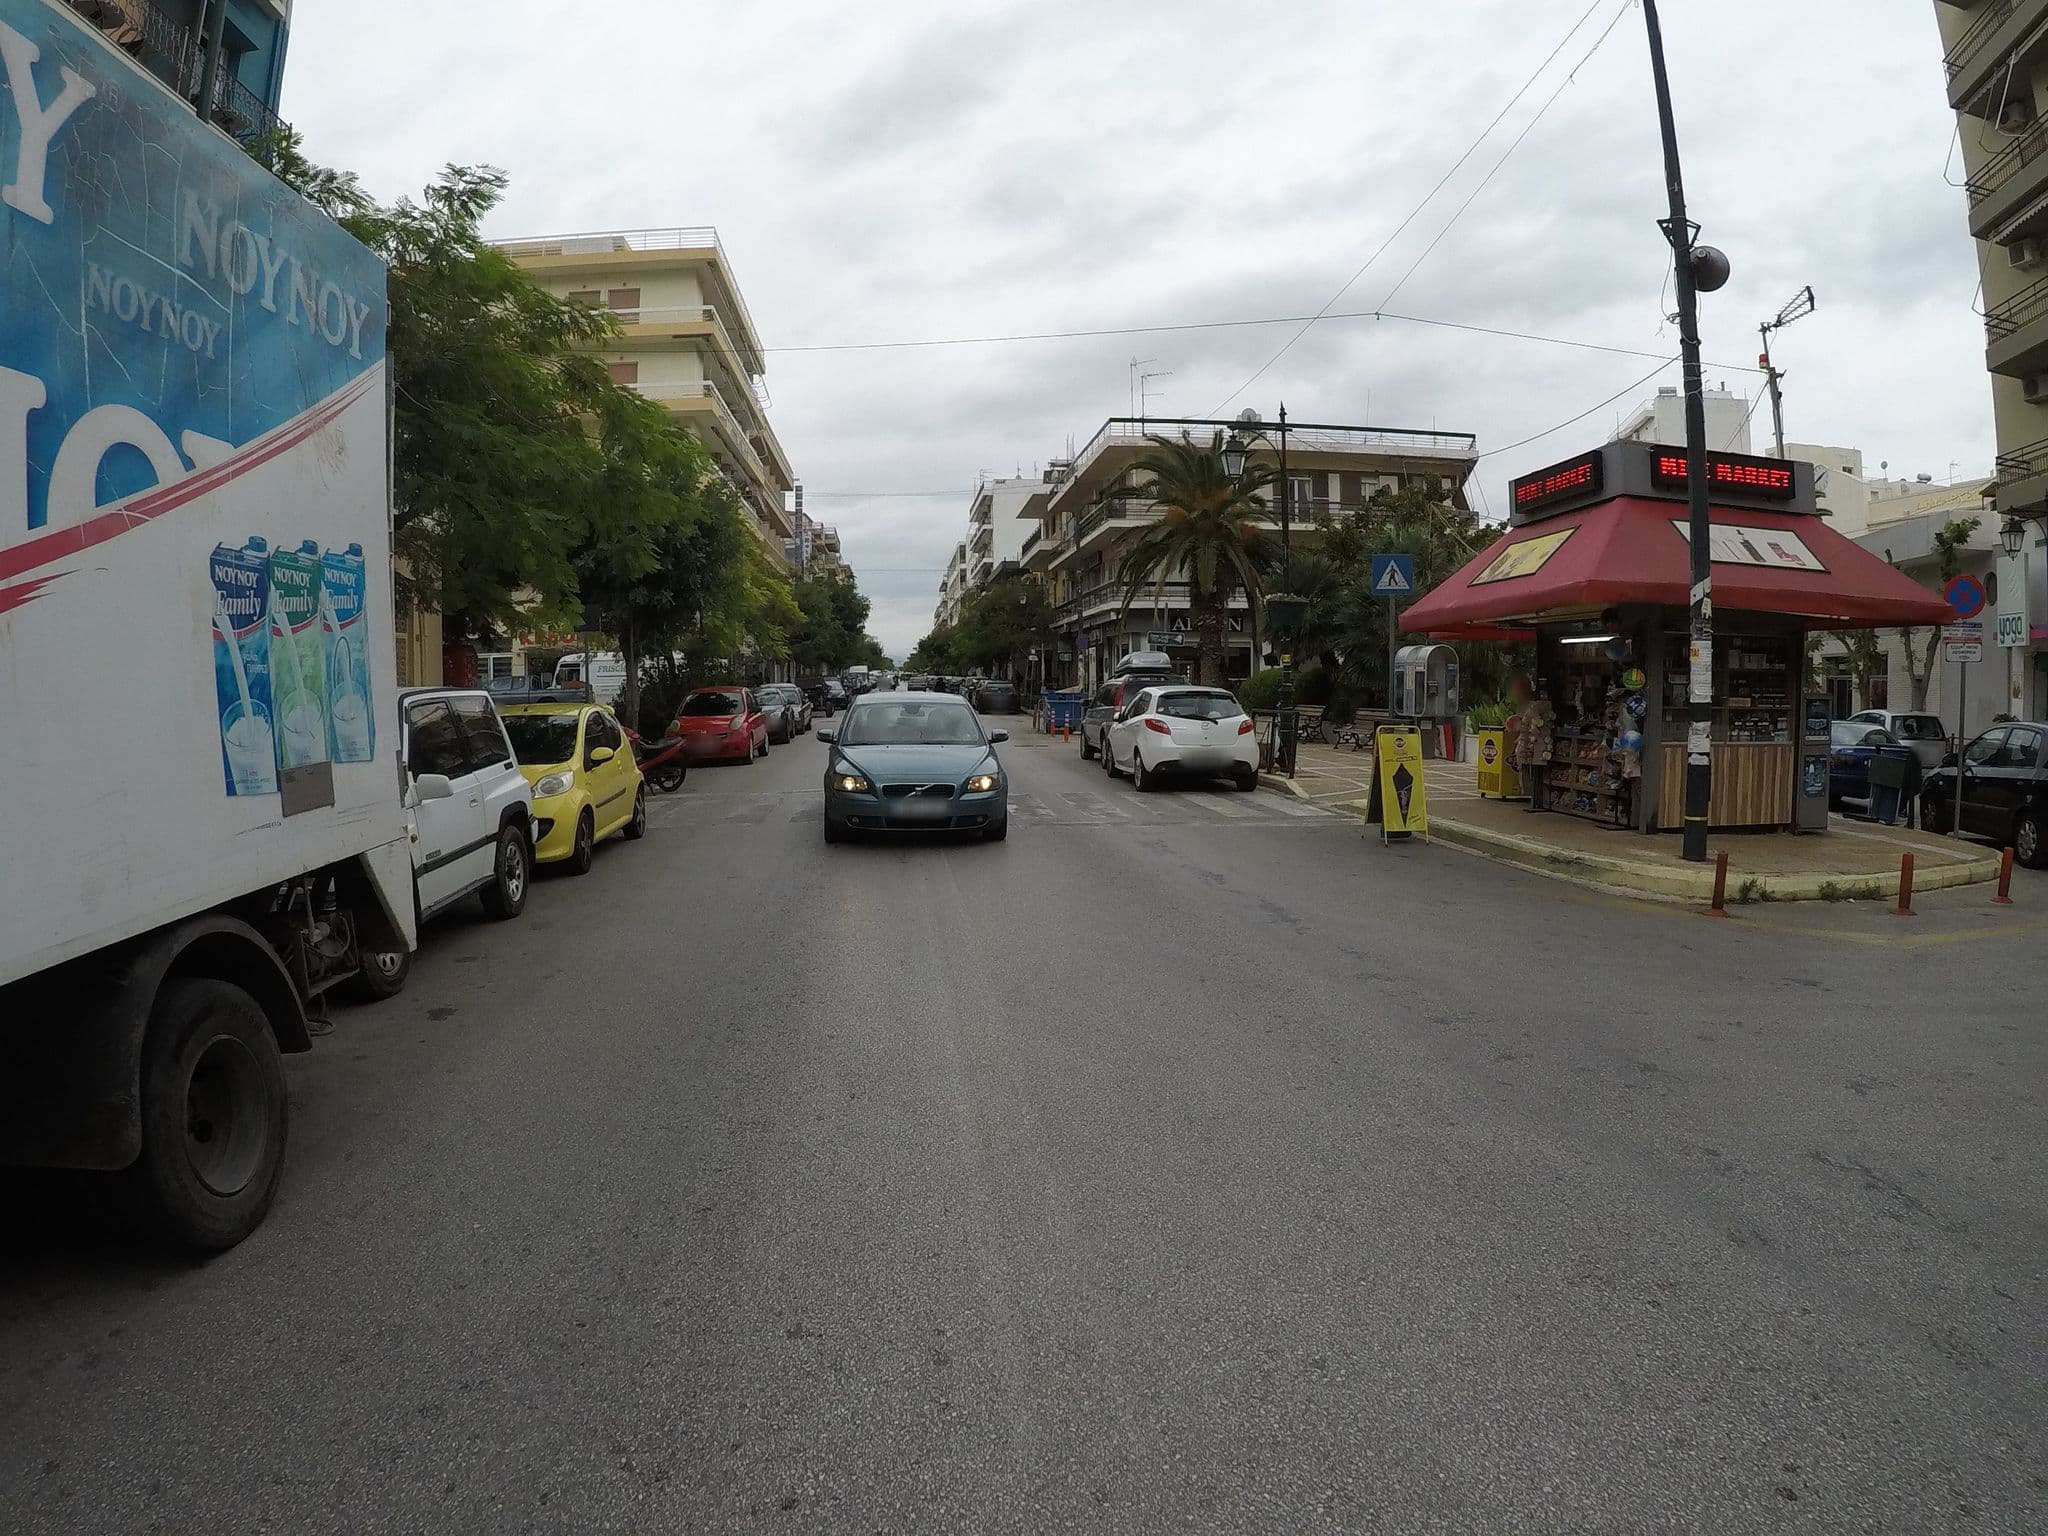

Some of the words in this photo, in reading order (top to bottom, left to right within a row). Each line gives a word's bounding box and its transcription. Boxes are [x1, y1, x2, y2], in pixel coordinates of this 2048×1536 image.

[179, 187, 371, 361] NOYNOY
[86, 262, 223, 359] NOYNOY
[1716, 463, 1791, 488] MARKET
[215, 565, 258, 588] NOYNOY
[275, 567, 312, 588] NOYNOY
[325, 567, 357, 587] NOYNOY
[215, 590, 262, 620] Family
[275, 590, 314, 617] Family
[326, 588, 359, 614] Family
[1999, 616, 2022, 644] yogo
